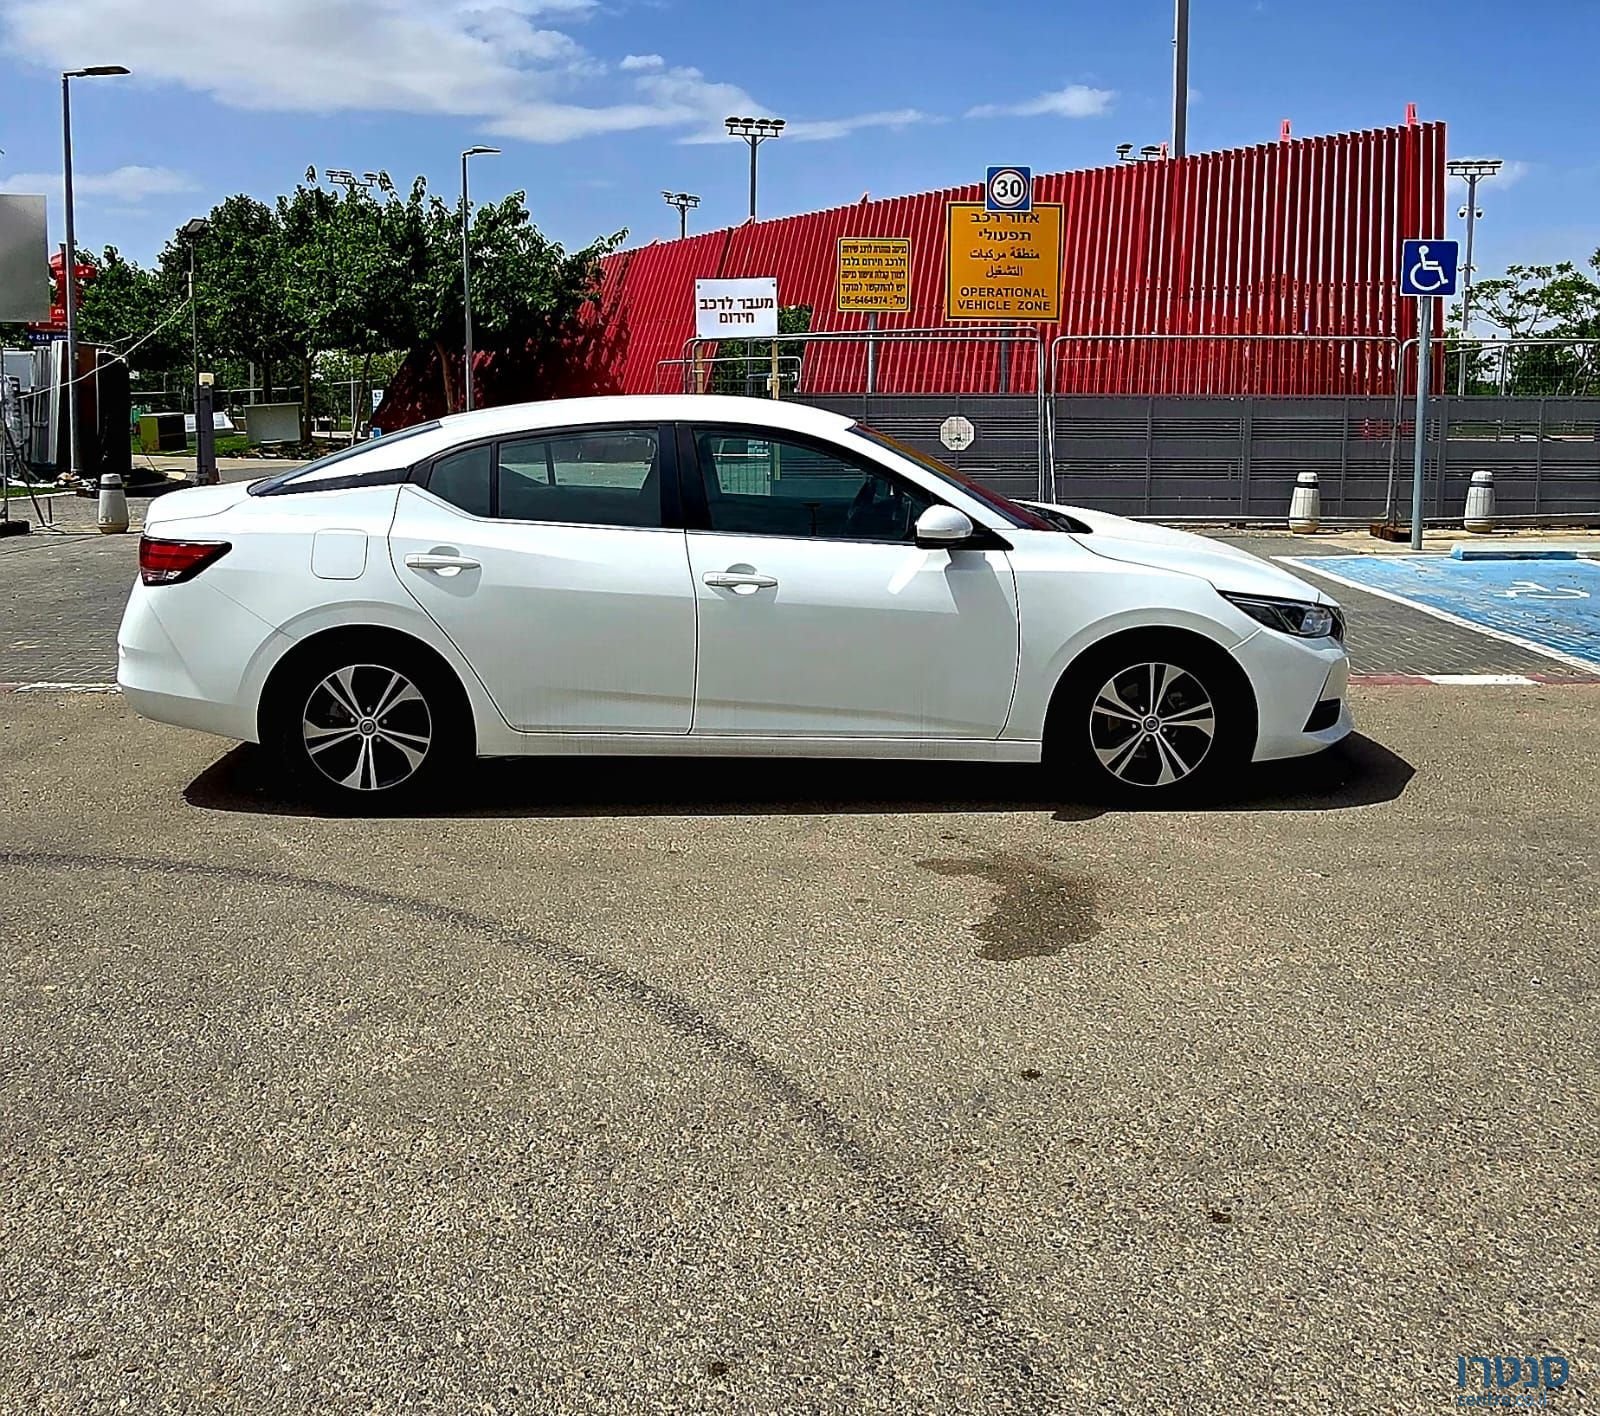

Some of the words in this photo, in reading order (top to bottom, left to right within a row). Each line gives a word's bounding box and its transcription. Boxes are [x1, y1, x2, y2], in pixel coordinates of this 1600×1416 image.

[996, 179, 1022, 198] 30
[970, 212, 1001, 223] רכב
[1006, 213, 1040, 224] אזור
[979, 228, 1031, 241] תפעולי
[970, 248, 1007, 261] مركبات
[1010, 247, 1040, 260] منطقة
[862, 258, 883, 266] חירום
[986, 264, 1023, 279] التشغيل
[960, 287, 1048, 298] OPERATIONAL
[699, 296, 734, 310] לרכב
[737, 297, 774, 309] מעבר
[957, 299, 1010, 310] VEHICLE
[1017, 300, 1051, 311] ZONE
[719, 312, 755, 323] חירום
